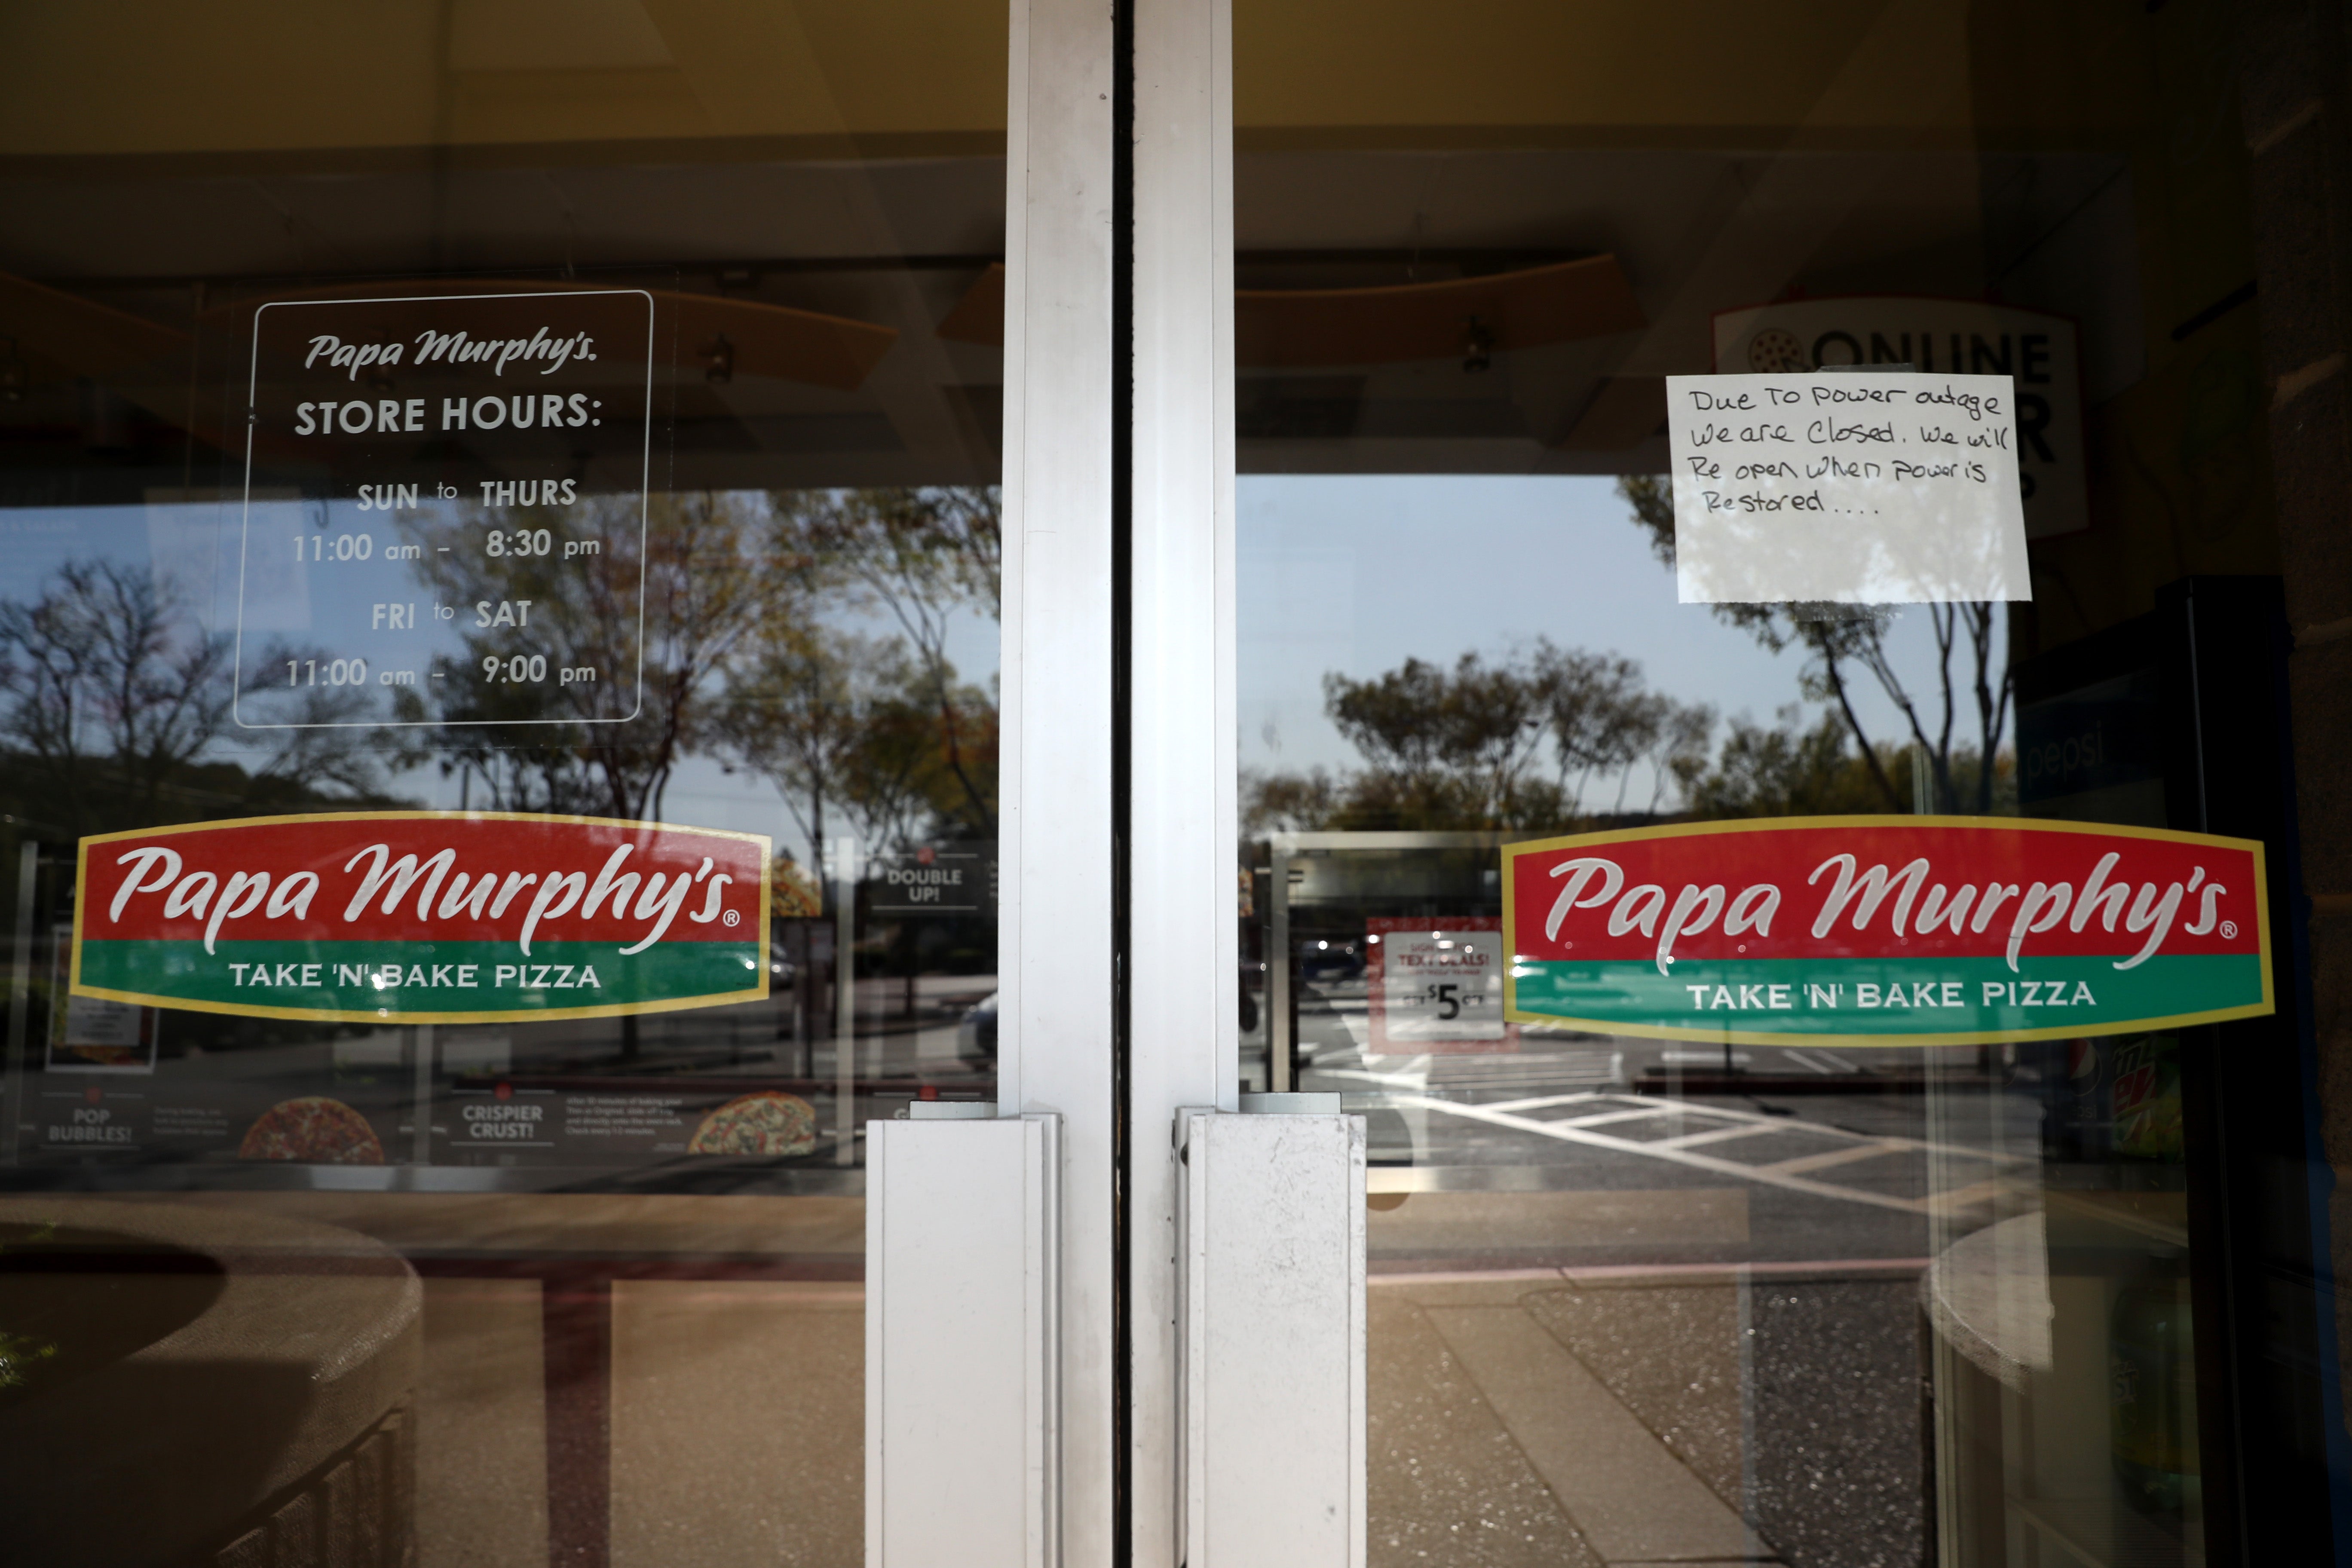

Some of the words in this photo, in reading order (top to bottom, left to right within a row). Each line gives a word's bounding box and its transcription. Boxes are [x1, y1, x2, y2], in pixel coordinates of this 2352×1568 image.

[304, 334, 404, 381] Papa
[294, 398, 425, 436] STORE
[442, 392, 602, 431] HOURS:
[1689, 391, 1757, 410] Due
[1916, 385, 2001, 420] outage
[1691, 423, 1733, 447] We
[1740, 424, 1795, 442] are
[1920, 426, 1959, 444] We
[1967, 427, 2007, 450] will
[1965, 461, 1986, 483] is
[357, 482, 418, 511] SUN
[437, 481, 458, 499] to
[480, 478, 576, 508] THURS
[293, 534, 373, 562] 11:00
[385, 544, 421, 560] am
[486, 529, 551, 557] 8:30
[564, 539, 600, 560] pm
[372, 603, 415, 630] FRI
[434, 602, 454, 620] to
[475, 600, 532, 628] SAT
[287, 658, 367, 686] 11:00
[380, 669, 415, 685] am
[482, 655, 547, 683] 9:00
[560, 665, 596, 686] pm
[2027, 720, 2103, 790] pepsi
[887, 869, 962, 885] DOUBLE
[109, 846, 320, 956] Papa
[909, 886, 940, 902] UP!
[1545, 857, 1782, 977] Papa
[228, 963, 322, 987] TAKE
[381, 964, 479, 988] BAKE
[495, 965, 601, 988] PIZZA
[1686, 984, 1792, 1010] TAKE
[1856, 982, 1965, 1008] BAKE
[1982, 981, 2097, 1007] PIZZA
[73, 1109, 110, 1124] POP
[462, 1105, 543, 1121] CRISPIER
[48, 1125, 132, 1143] BUBBLES!
[469, 1122, 534, 1138] CRUST!
